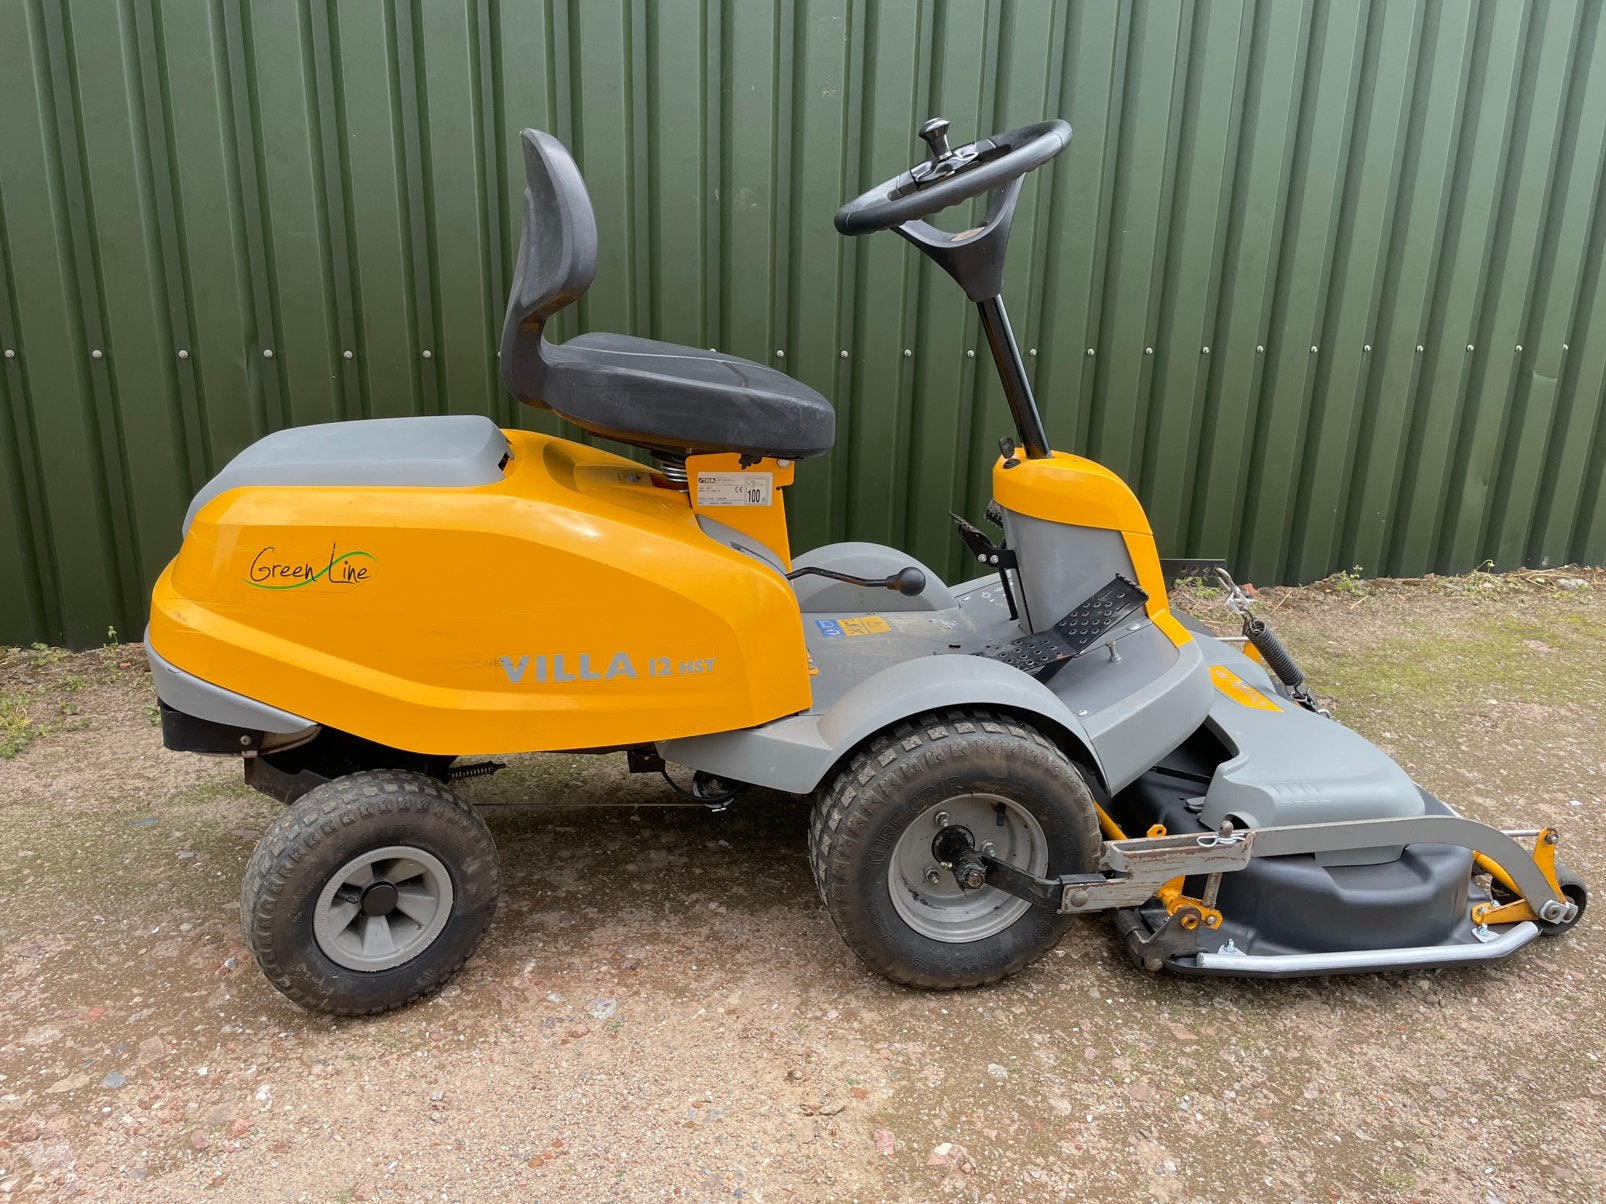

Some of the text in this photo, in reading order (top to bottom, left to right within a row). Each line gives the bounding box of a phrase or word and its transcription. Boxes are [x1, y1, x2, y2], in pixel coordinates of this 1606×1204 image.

[747, 489, 761, 503] 100
[250, 542, 370, 584] Green Line
[499, 651, 716, 684] VILLA 12 HST
